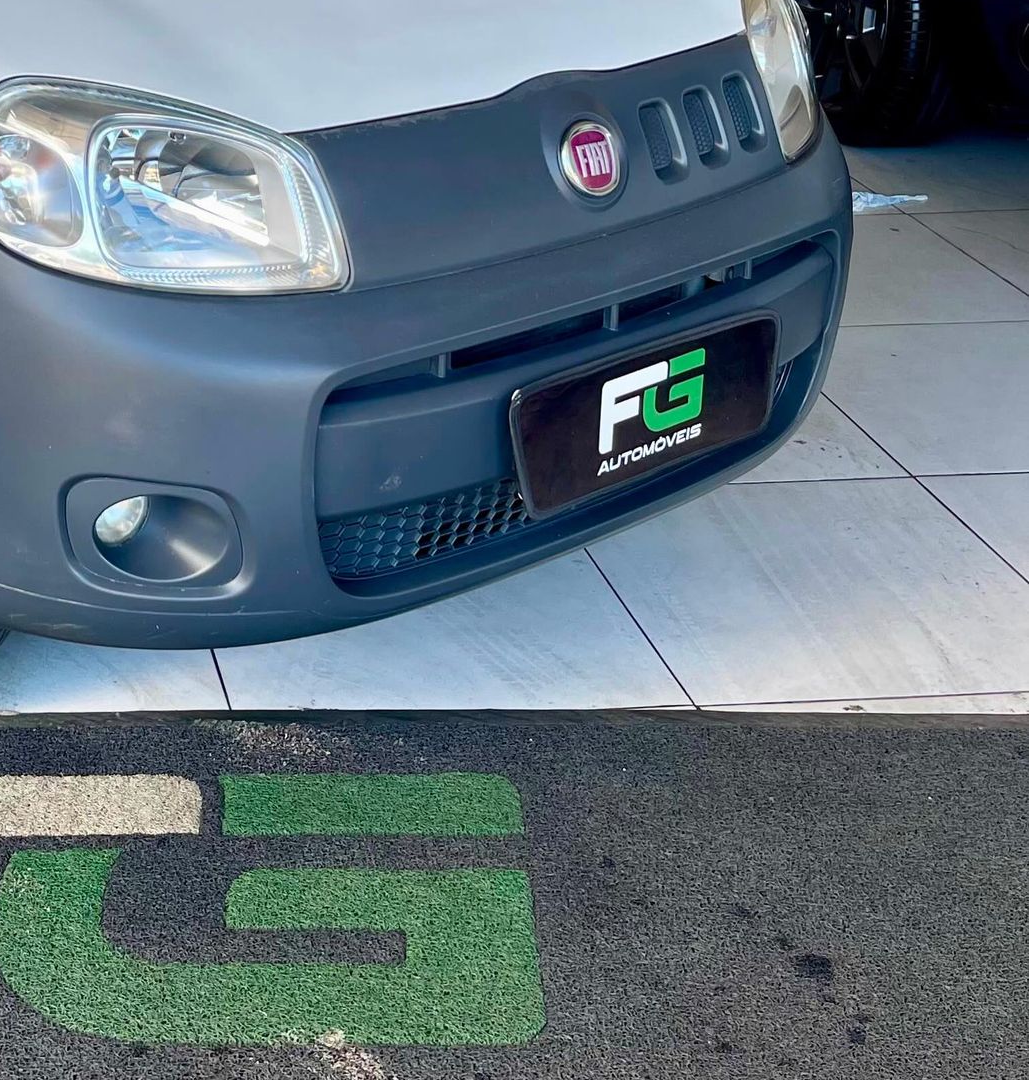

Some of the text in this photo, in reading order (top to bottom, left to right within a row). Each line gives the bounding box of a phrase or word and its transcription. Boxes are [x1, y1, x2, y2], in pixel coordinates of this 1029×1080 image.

[575, 141, 614, 179] FIAT
[597, 348, 707, 456] FG
[596, 423, 703, 478] AUTOMÓVEIS
